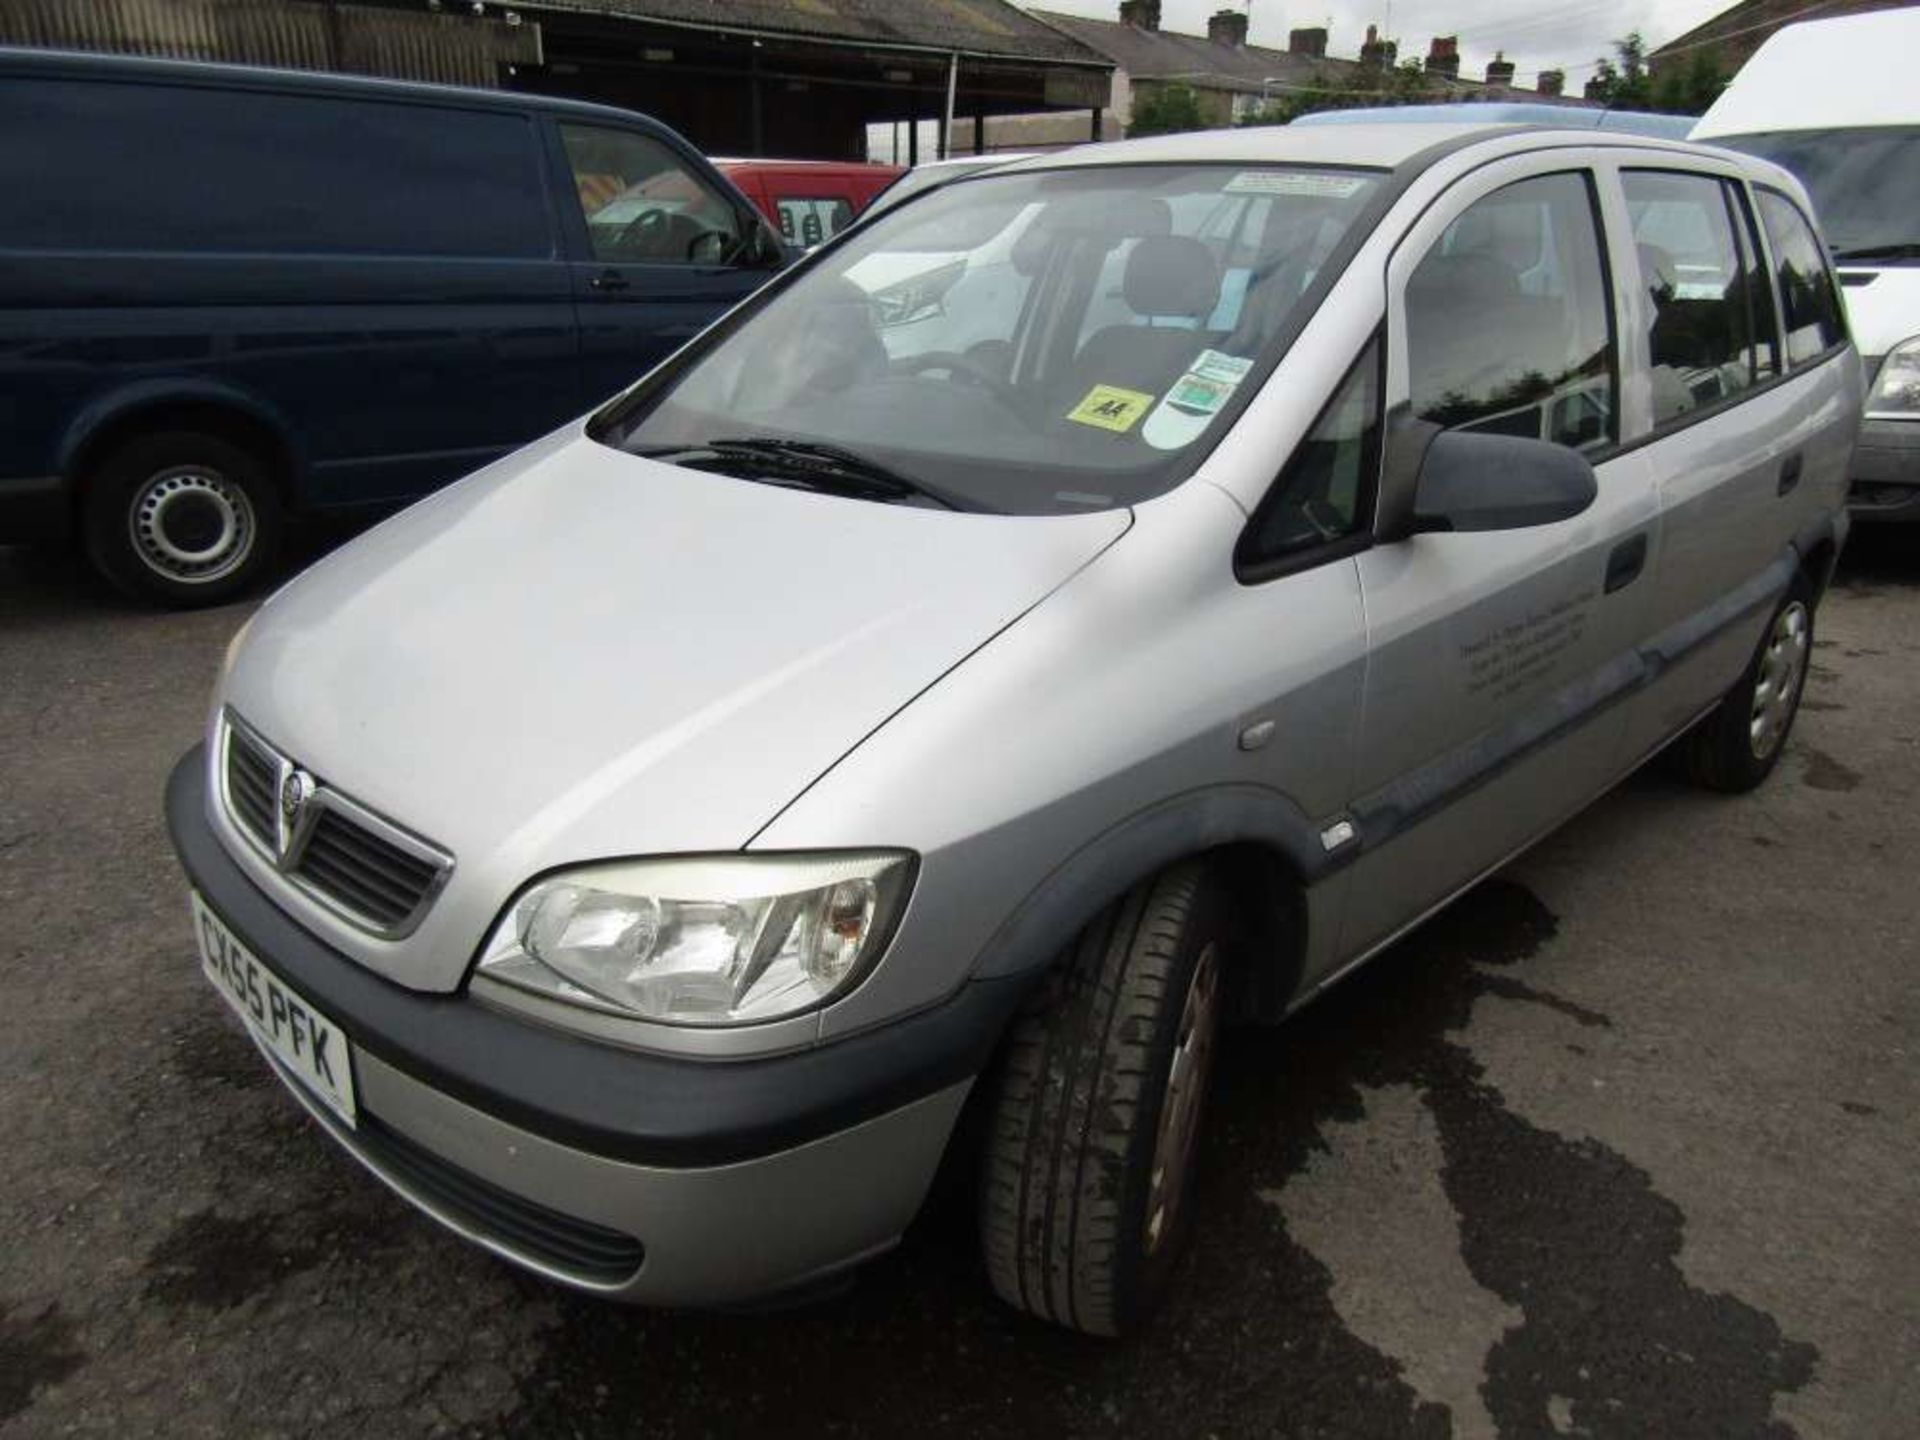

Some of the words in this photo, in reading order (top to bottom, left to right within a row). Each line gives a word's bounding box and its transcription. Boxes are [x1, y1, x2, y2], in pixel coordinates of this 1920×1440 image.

[1094, 399, 1126, 417] AA
[201, 911, 264, 1020] CX55
[266, 980, 335, 1088] PFK
